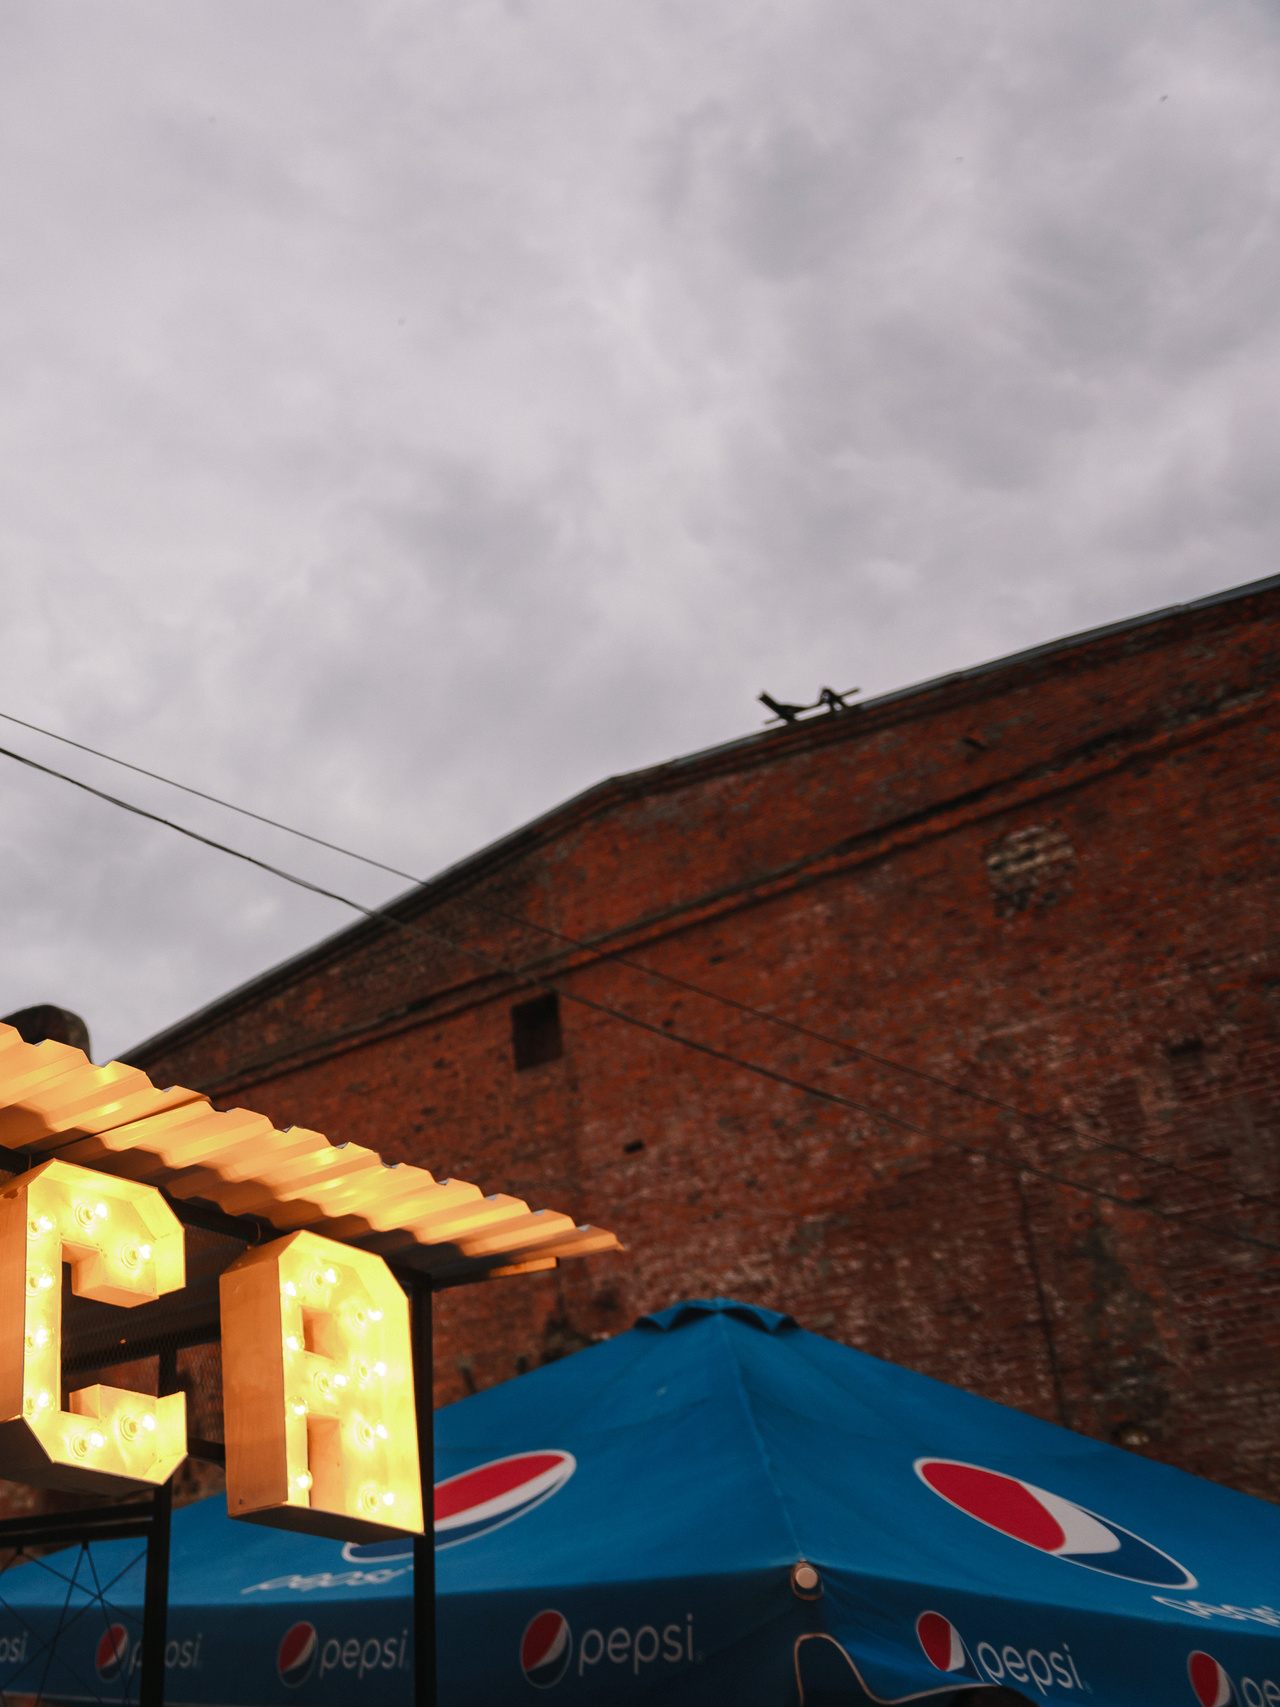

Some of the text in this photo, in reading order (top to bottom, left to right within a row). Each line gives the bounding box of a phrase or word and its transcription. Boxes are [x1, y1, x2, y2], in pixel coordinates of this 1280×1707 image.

[1150, 1595, 1280, 1628] pep
[128, 1632, 203, 1675] ppsi
[319, 1628, 409, 1680] pepsi
[579, 1613, 695, 1676] pepsi
[977, 1638, 1084, 1697] pepsi
